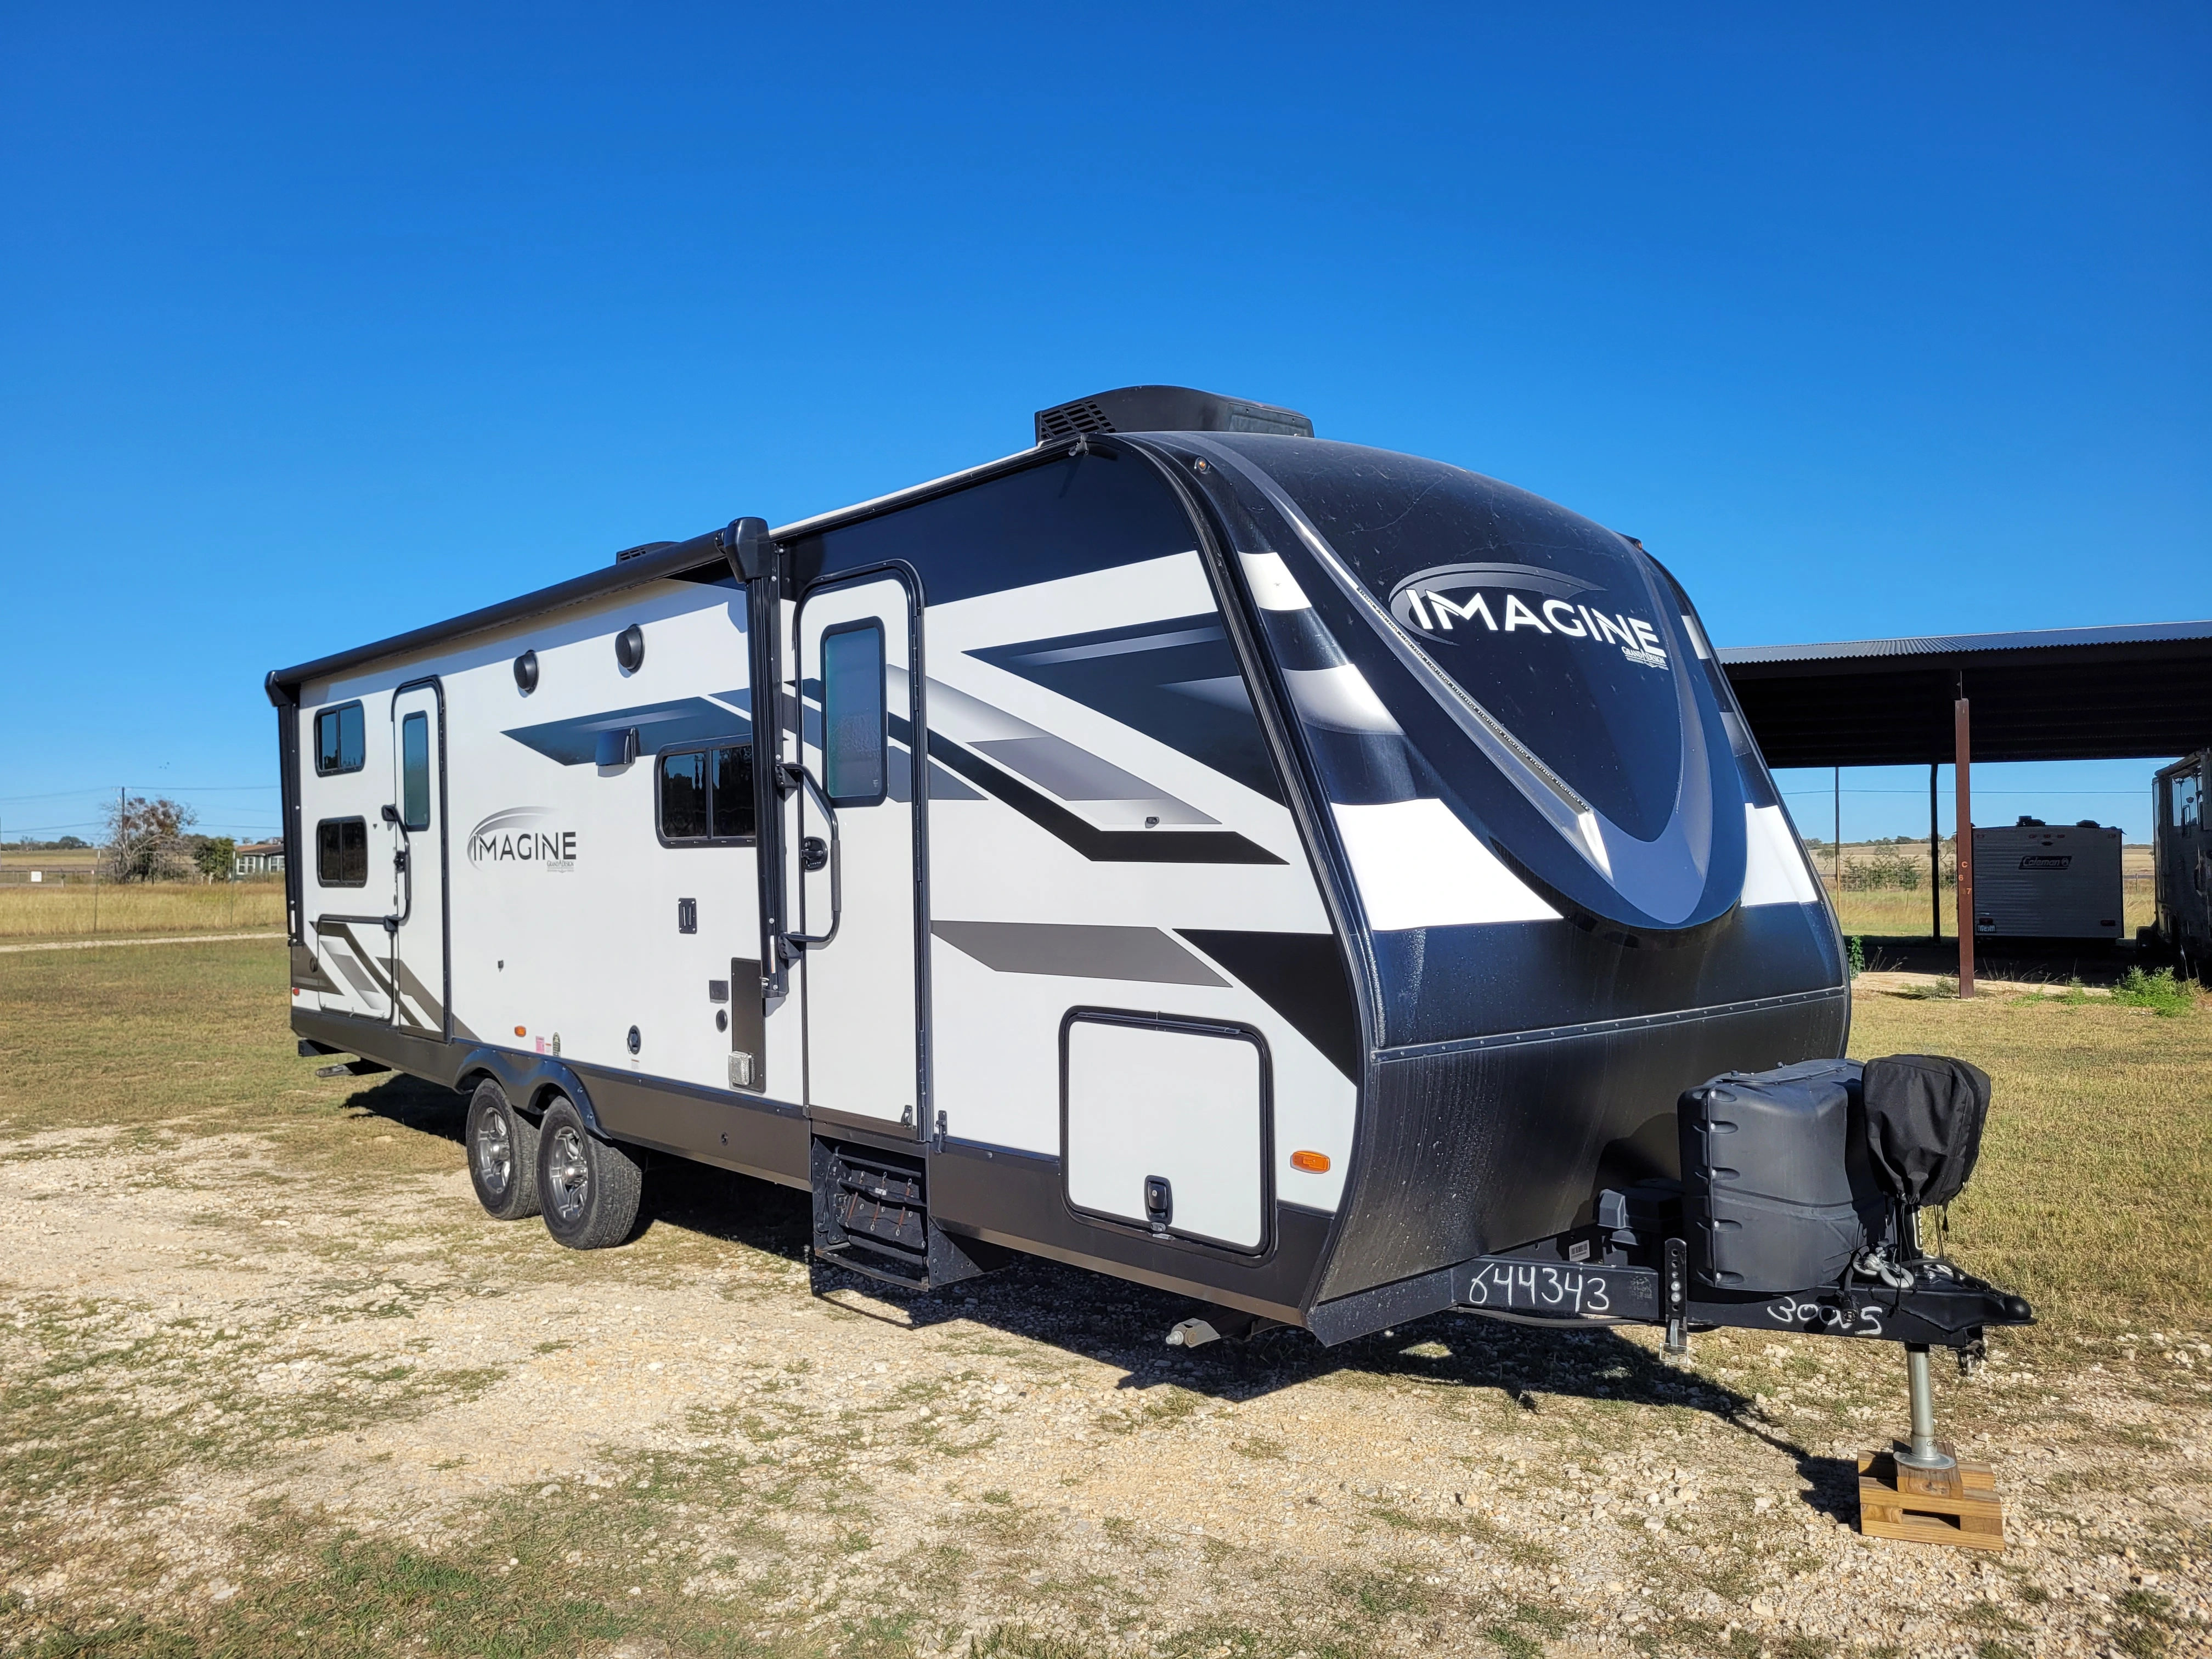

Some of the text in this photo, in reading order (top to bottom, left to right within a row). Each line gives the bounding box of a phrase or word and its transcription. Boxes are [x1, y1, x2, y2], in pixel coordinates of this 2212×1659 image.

[1405, 589, 1667, 658] IMAGINE
[473, 831, 577, 861] IMAGINE
[2023, 857, 2060, 866] Coleman
[1469, 1263, 1610, 1313] 644343
